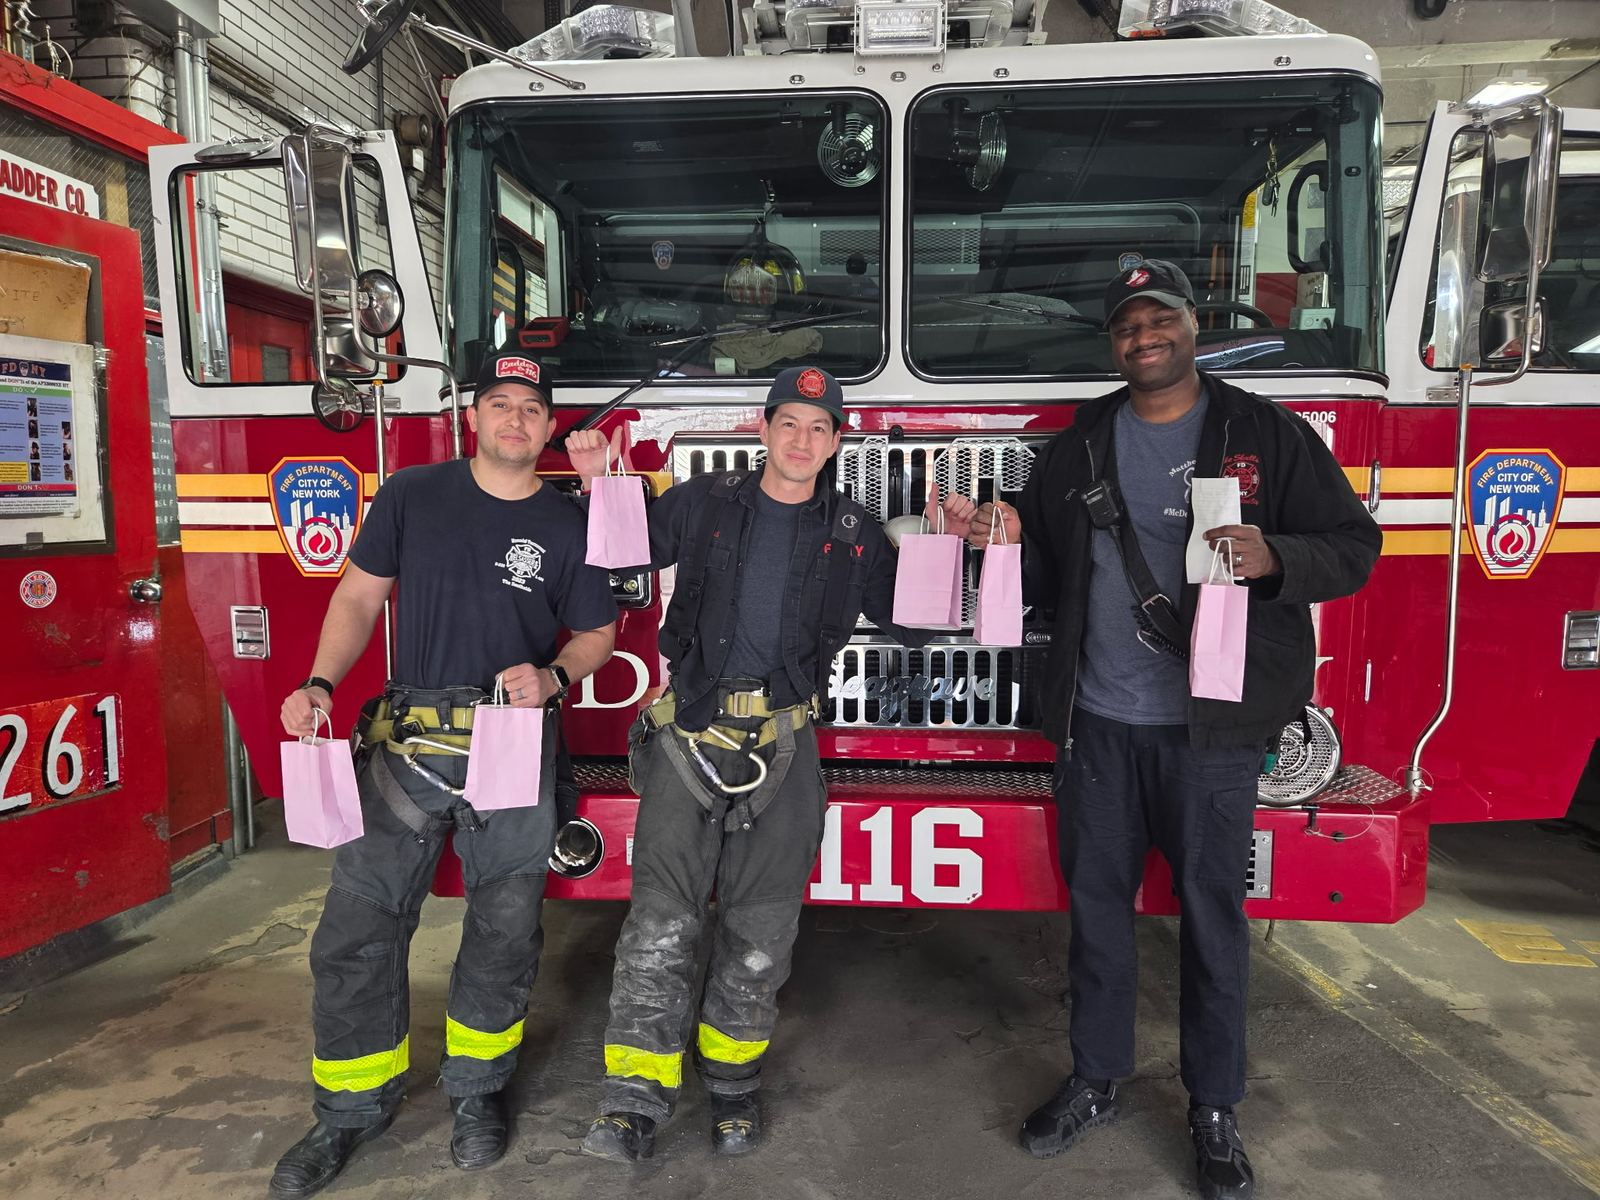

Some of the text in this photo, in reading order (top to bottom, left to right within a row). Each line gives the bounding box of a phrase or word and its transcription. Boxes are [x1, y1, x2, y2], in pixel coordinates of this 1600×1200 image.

[0, 159, 89, 216] ADDER CO.
[501, 360, 534, 371] Ladder
[525, 368, 537, 379] 116
[1477, 458, 1554, 488] FIRE DEPARTMENT
[1497, 473, 1534, 482] CITY OF
[280, 465, 353, 493] FIRE DEPARTMENT
[298, 479, 333, 488] CITY OF
[292, 489, 341, 498] NEW YORK
[1489, 484, 1540, 494] NEW YORK
[0, 695, 119, 812] 261
[809, 805, 984, 904] 116
